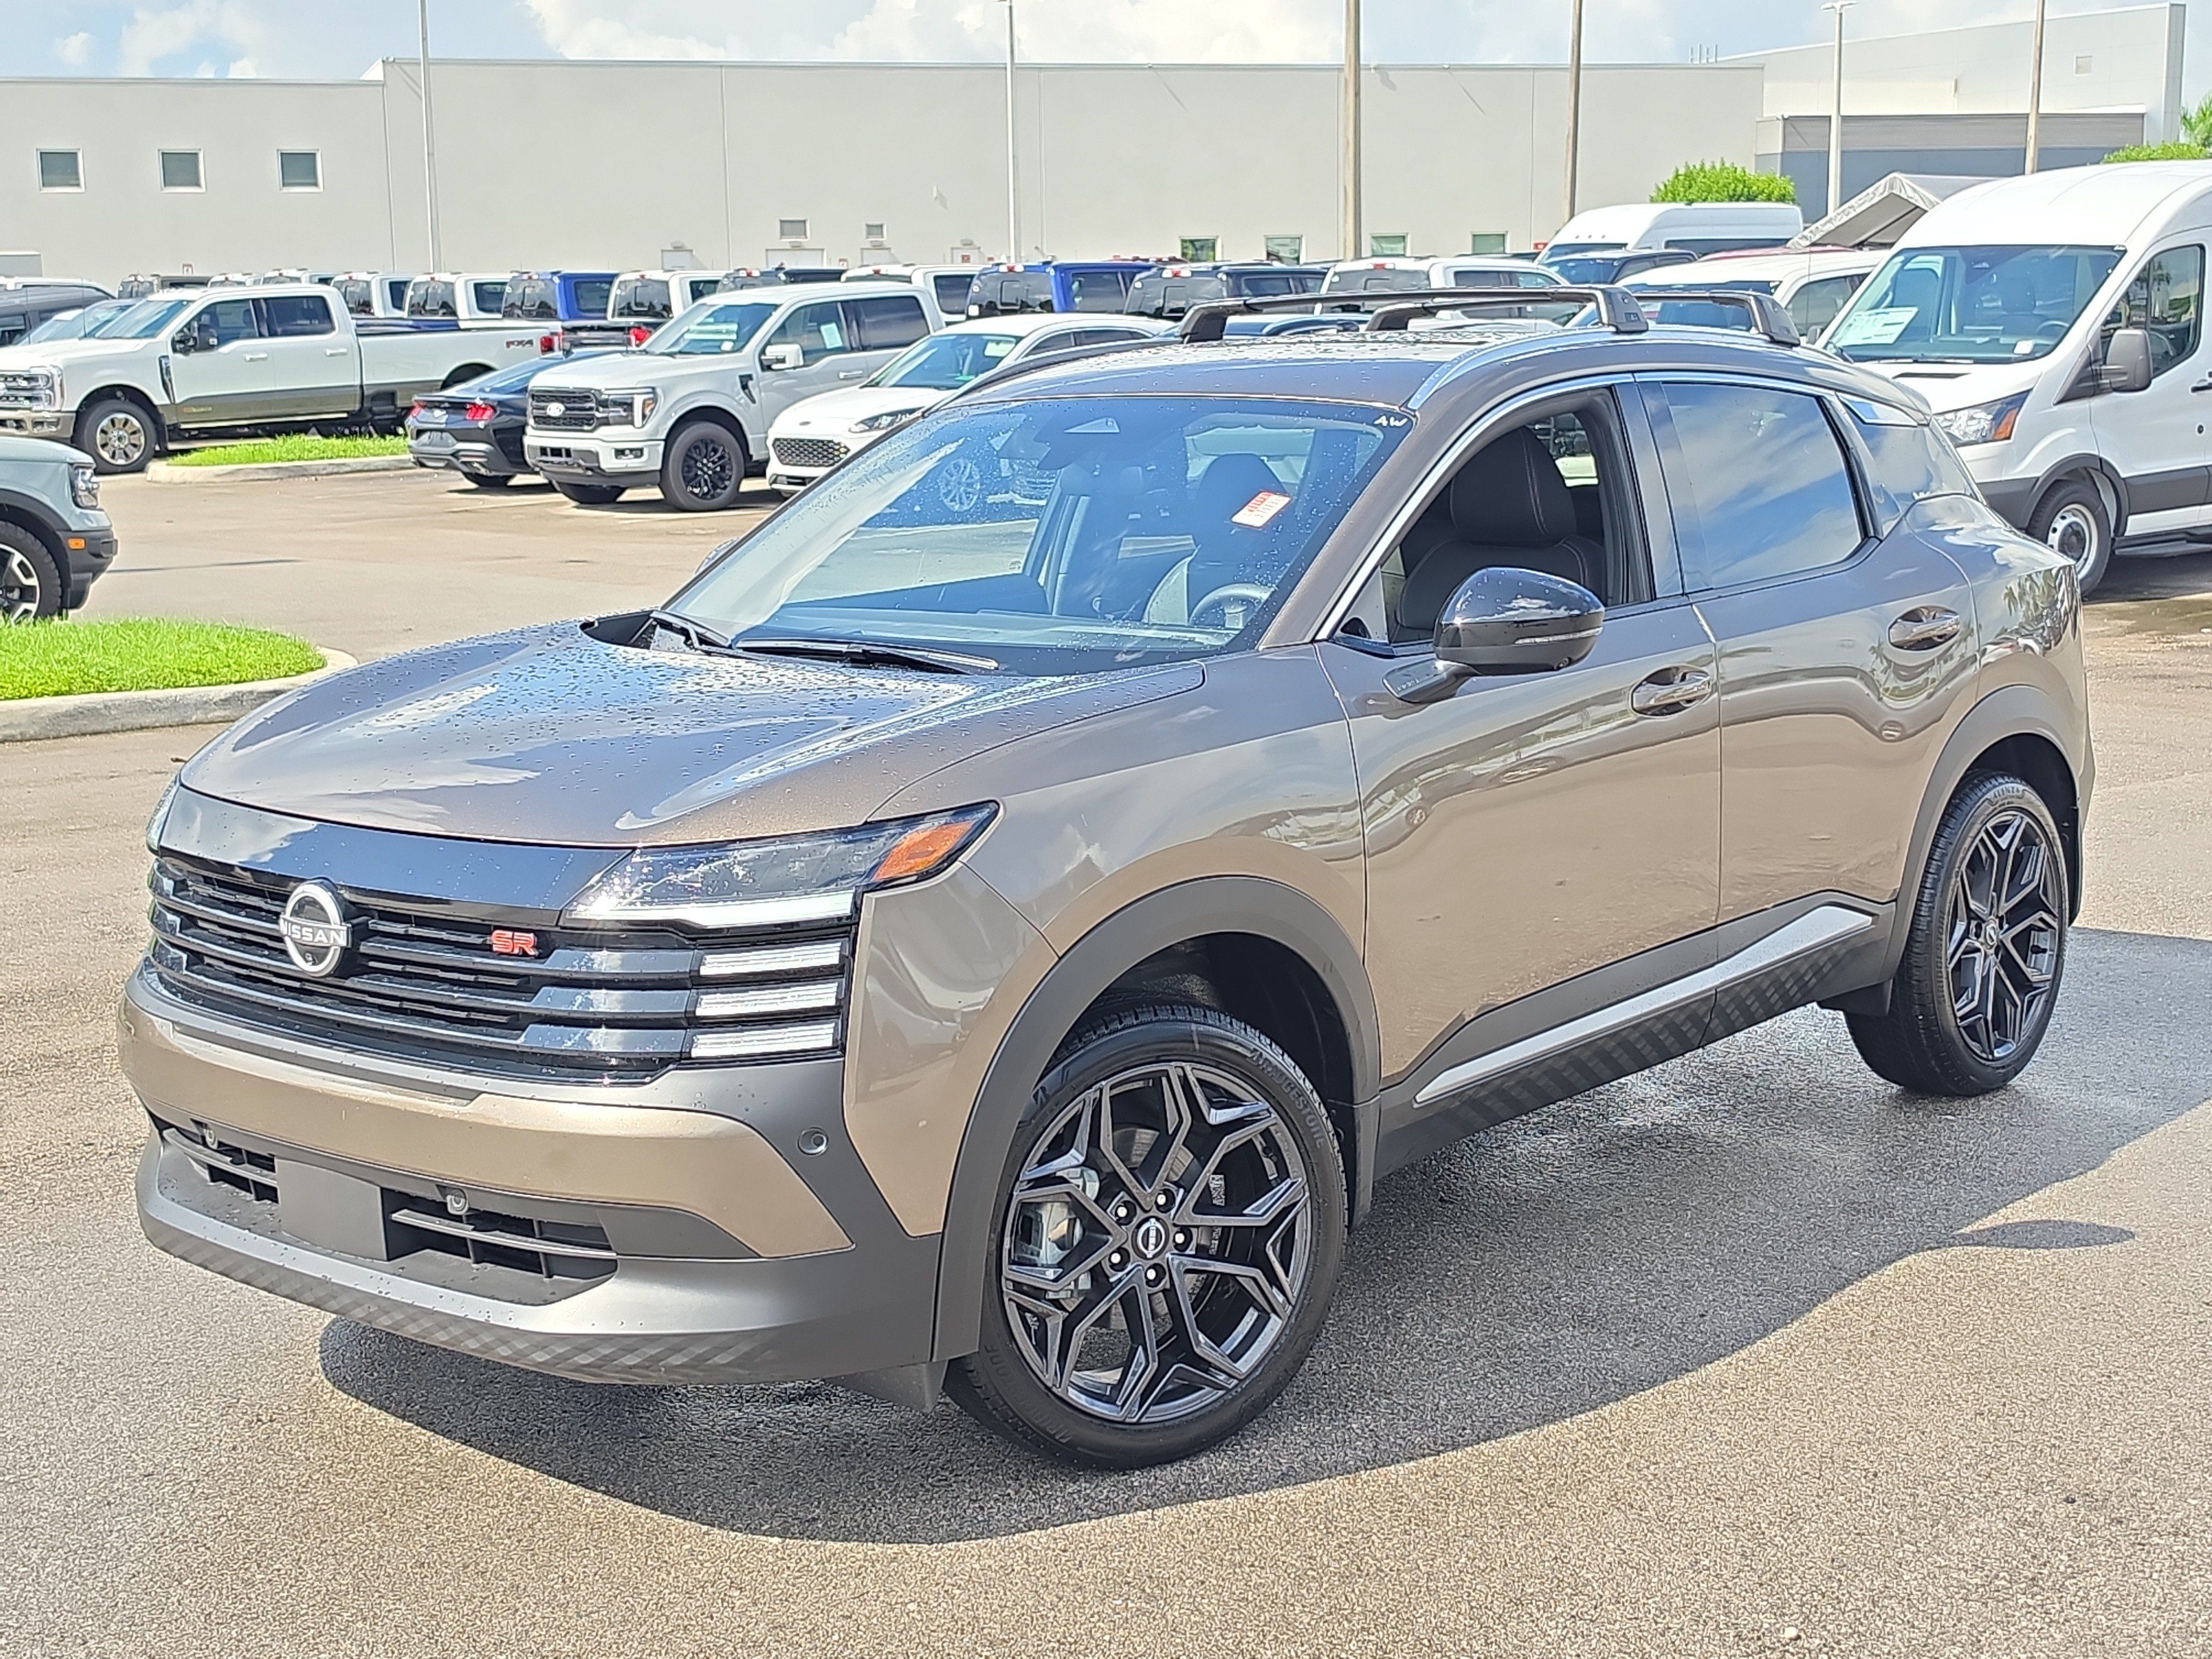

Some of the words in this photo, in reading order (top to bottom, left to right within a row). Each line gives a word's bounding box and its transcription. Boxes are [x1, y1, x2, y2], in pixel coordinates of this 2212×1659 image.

[280, 918, 344, 944] NISSAN
[492, 929, 536, 955] SR
[1250, 1047, 1325, 1149] BRIDGESTONE
